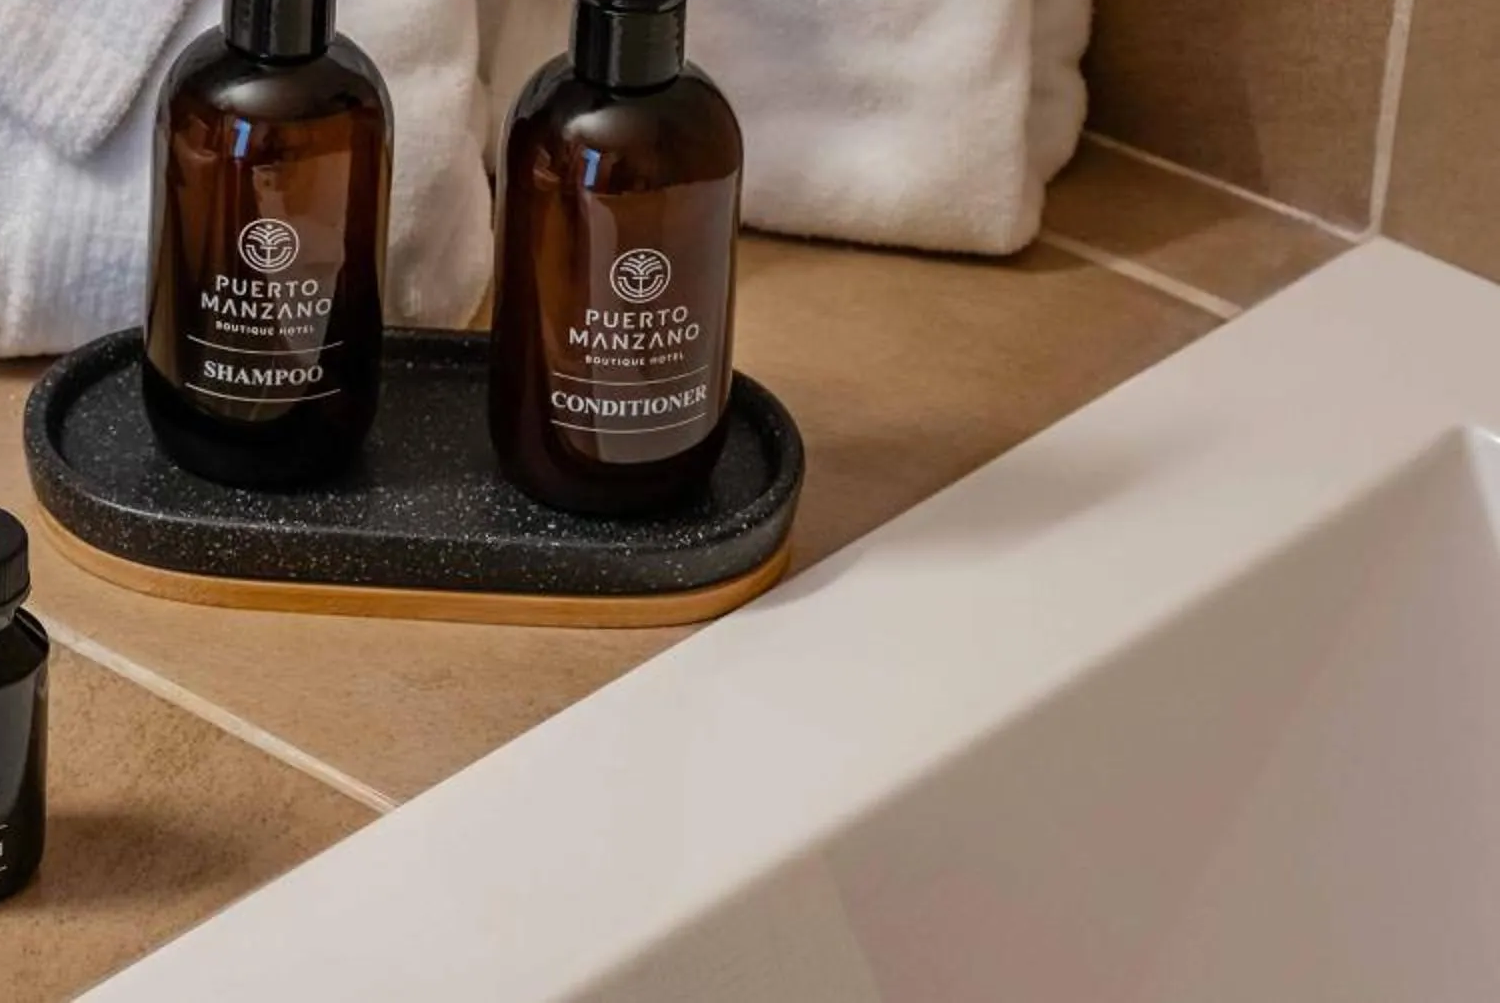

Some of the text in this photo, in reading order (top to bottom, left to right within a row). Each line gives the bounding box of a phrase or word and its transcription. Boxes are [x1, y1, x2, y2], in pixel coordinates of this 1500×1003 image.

[215, 274, 318, 298] PUERTO
[201, 291, 332, 320] MANZANO
[585, 306, 688, 328] PUERTO
[215, 321, 314, 336] BOUTIQUE HOTEL
[569, 323, 699, 350] MANZANO
[585, 352, 684, 366] BOUTIQUE HOTEL
[203, 360, 323, 386] SHAMPOO
[551, 384, 708, 417] CONDITIONER
